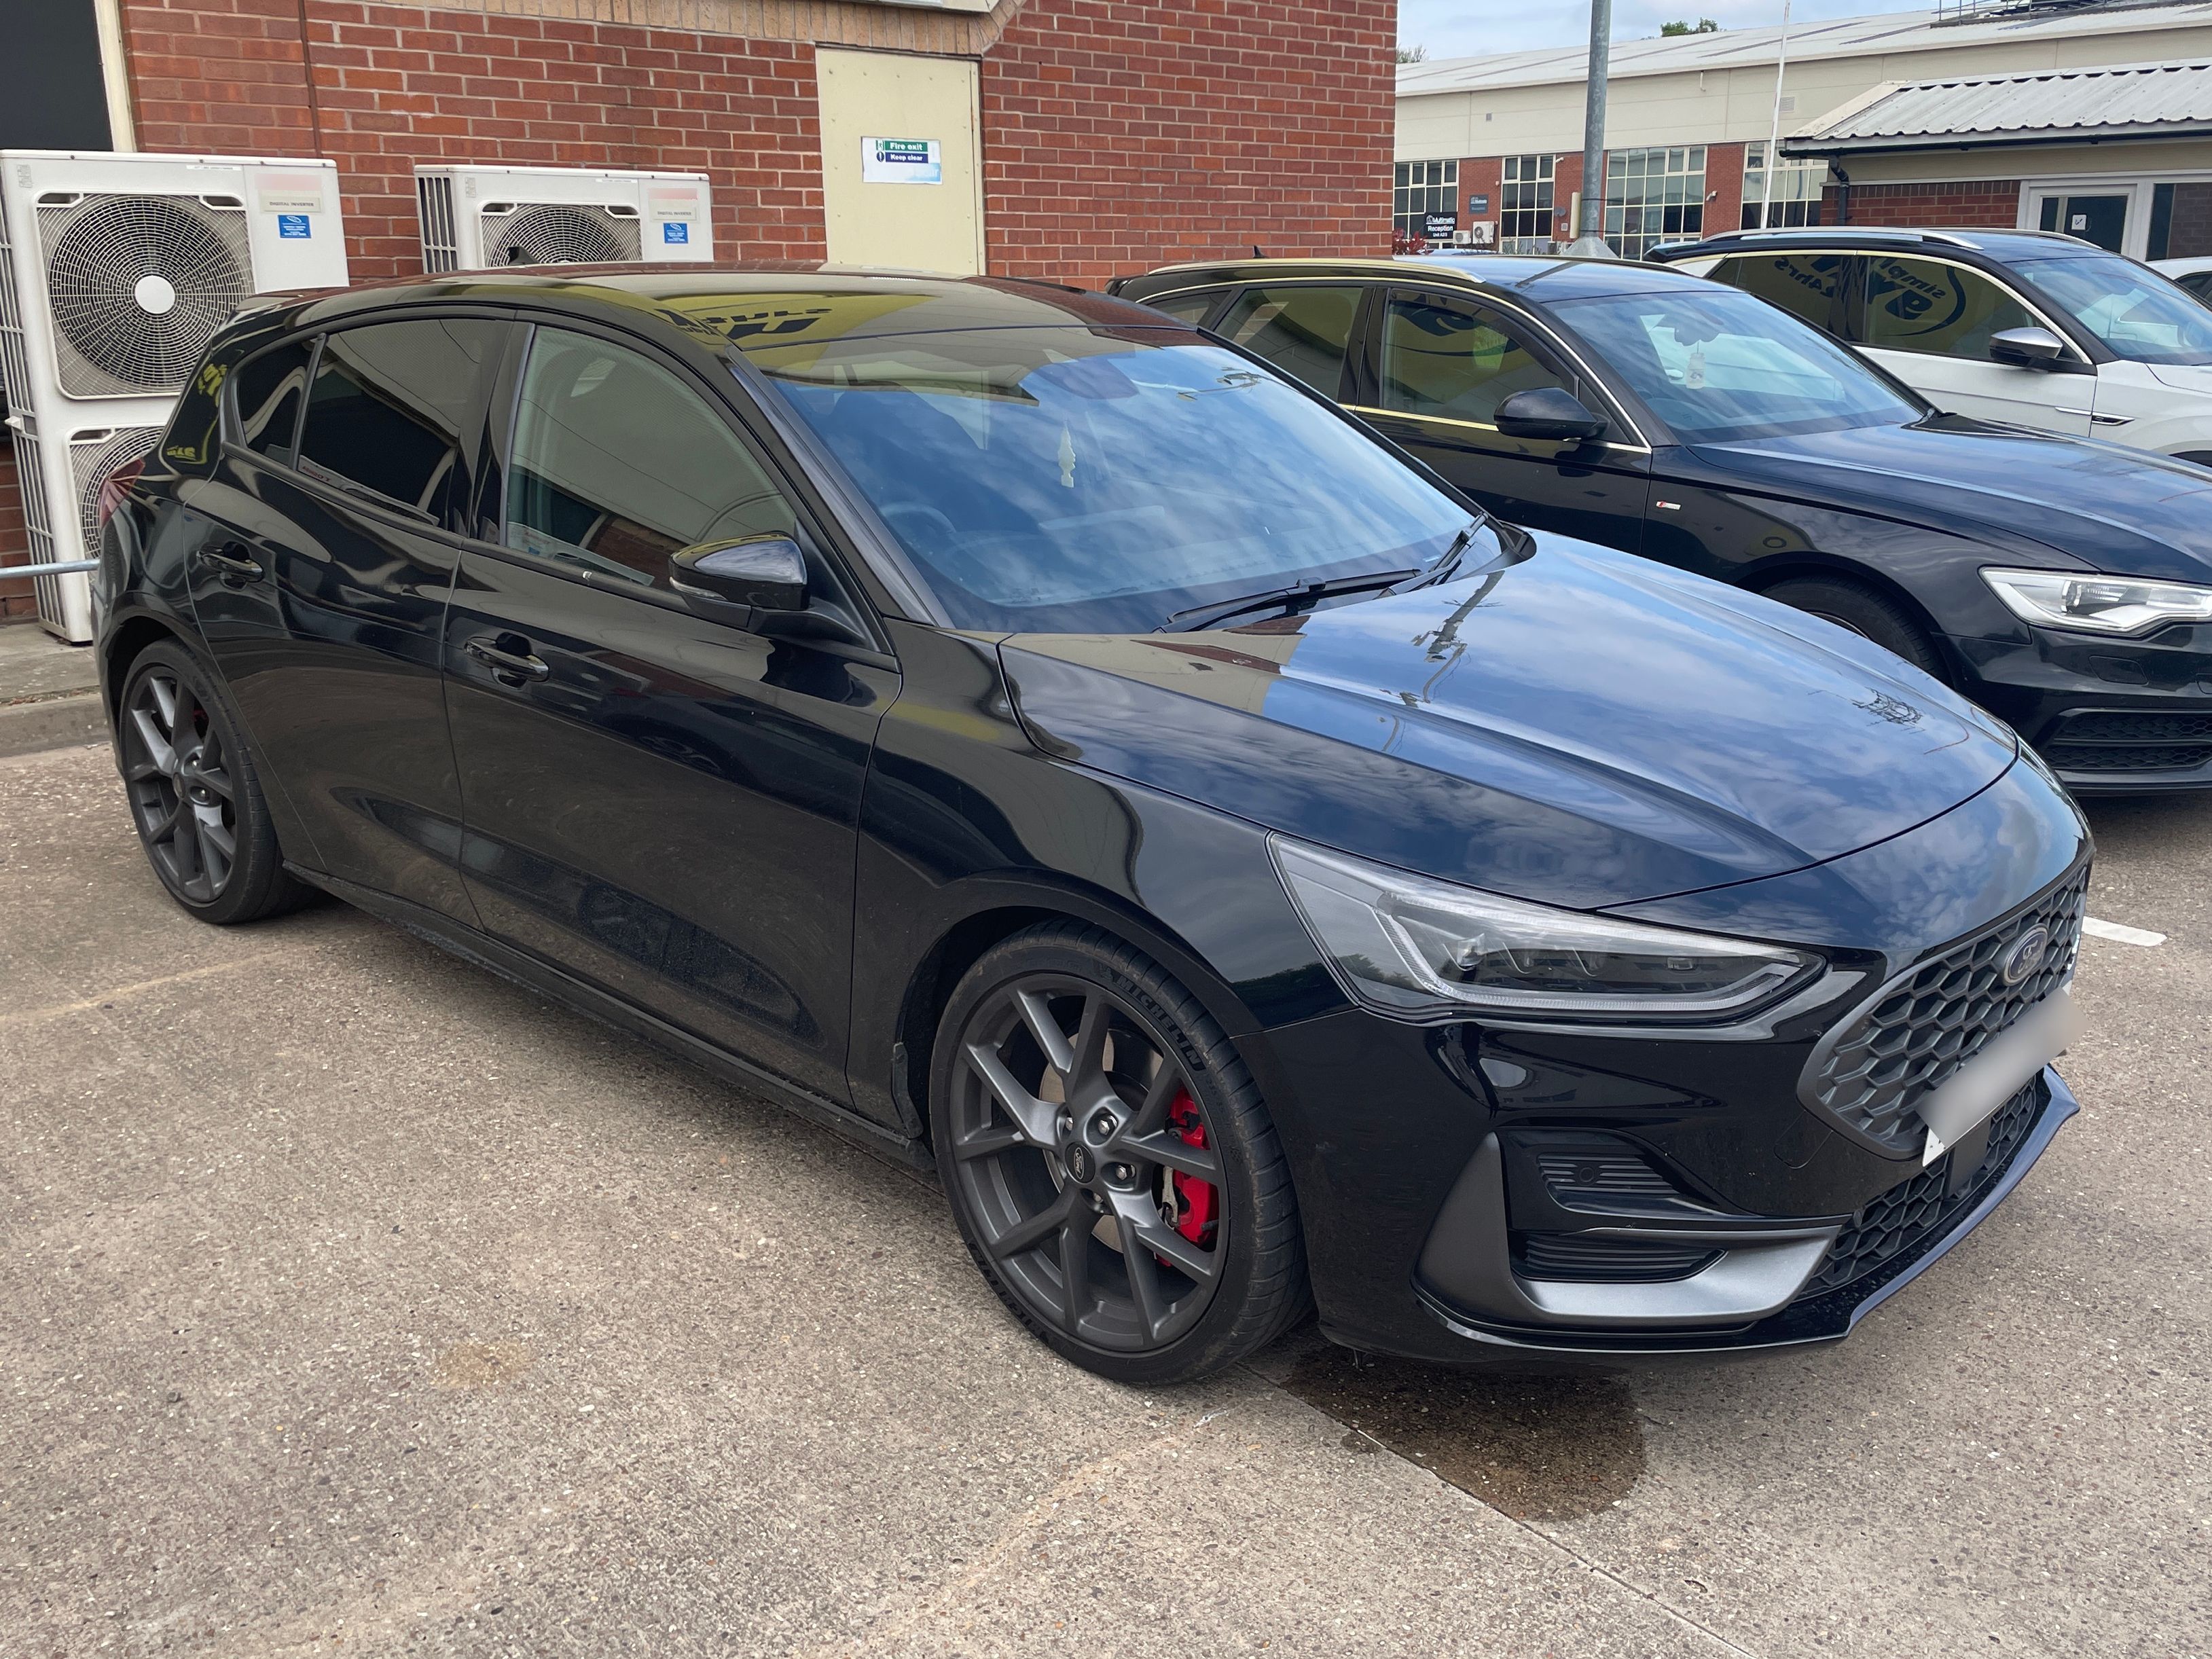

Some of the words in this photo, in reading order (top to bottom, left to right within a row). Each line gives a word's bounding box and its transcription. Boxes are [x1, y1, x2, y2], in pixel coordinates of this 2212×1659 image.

[890, 142, 906, 150] Fire
[907, 143, 923, 151] exit
[890, 153, 907, 162] Keep
[1116, 974, 1203, 1069] MICHELIN
